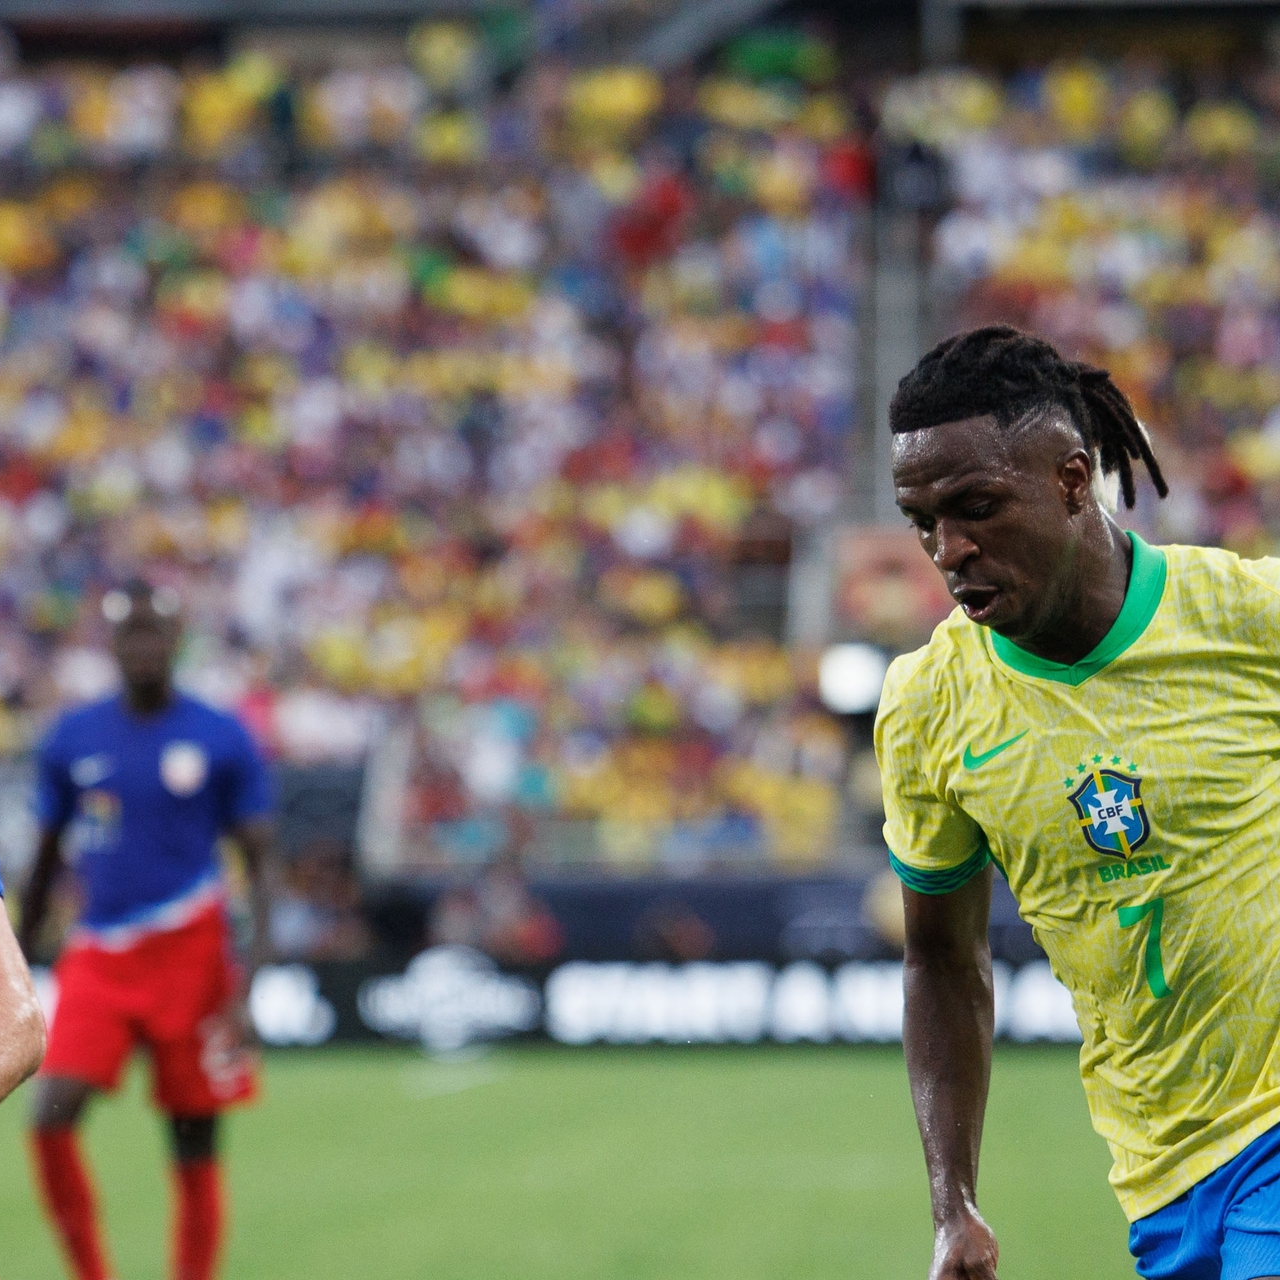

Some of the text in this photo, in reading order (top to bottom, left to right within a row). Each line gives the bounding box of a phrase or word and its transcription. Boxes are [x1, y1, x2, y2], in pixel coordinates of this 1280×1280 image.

[1097, 804, 1124, 820] CBF
[1097, 854, 1172, 883] BRASIL
[1117, 897, 1172, 999] 7
